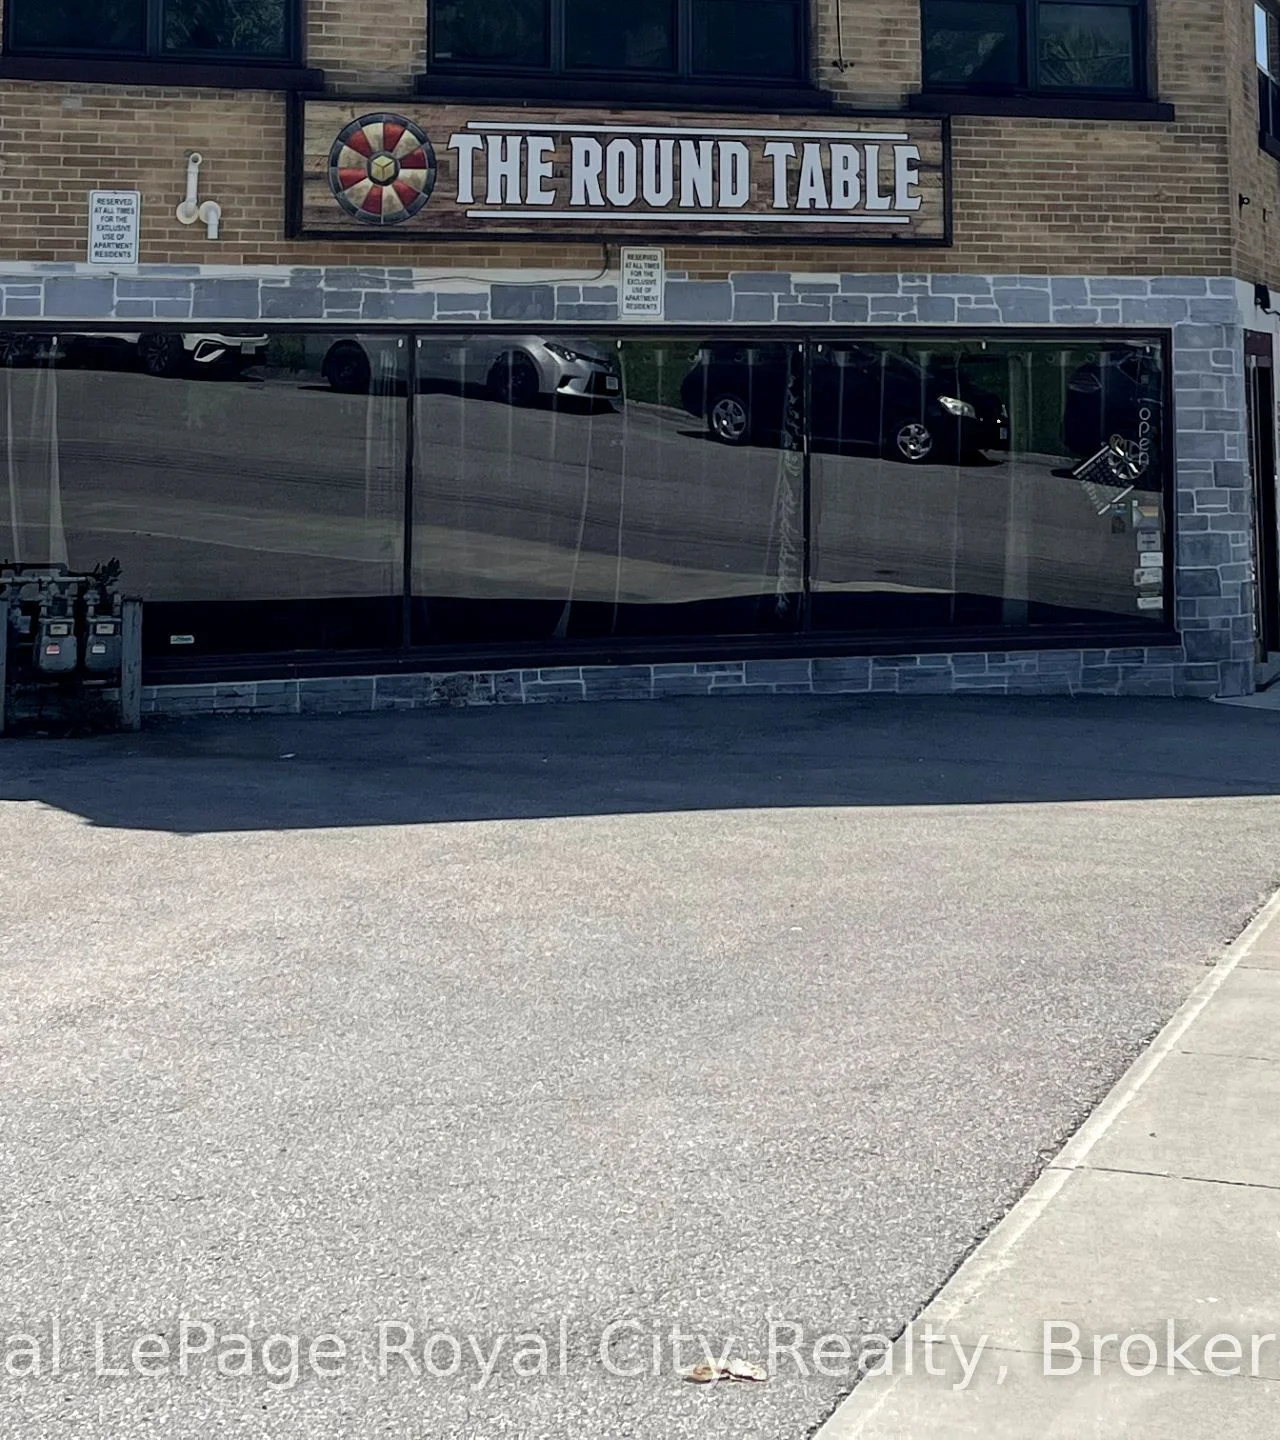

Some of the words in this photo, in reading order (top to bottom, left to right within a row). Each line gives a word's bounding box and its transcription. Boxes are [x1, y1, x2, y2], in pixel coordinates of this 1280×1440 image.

[447, 134, 557, 205] THE
[570, 137, 751, 208] ROUND
[763, 141, 922, 211] TABLE
[96, 197, 133, 206] RESERVED
[116, 207, 135, 215] TIMES
[100, 215, 114, 223] FOR
[115, 215, 128, 223] THE
[96, 224, 132, 232] EXCLUSIVE
[94, 250, 132, 258] RESIDENTS
[627, 253, 658, 261] RESERVED
